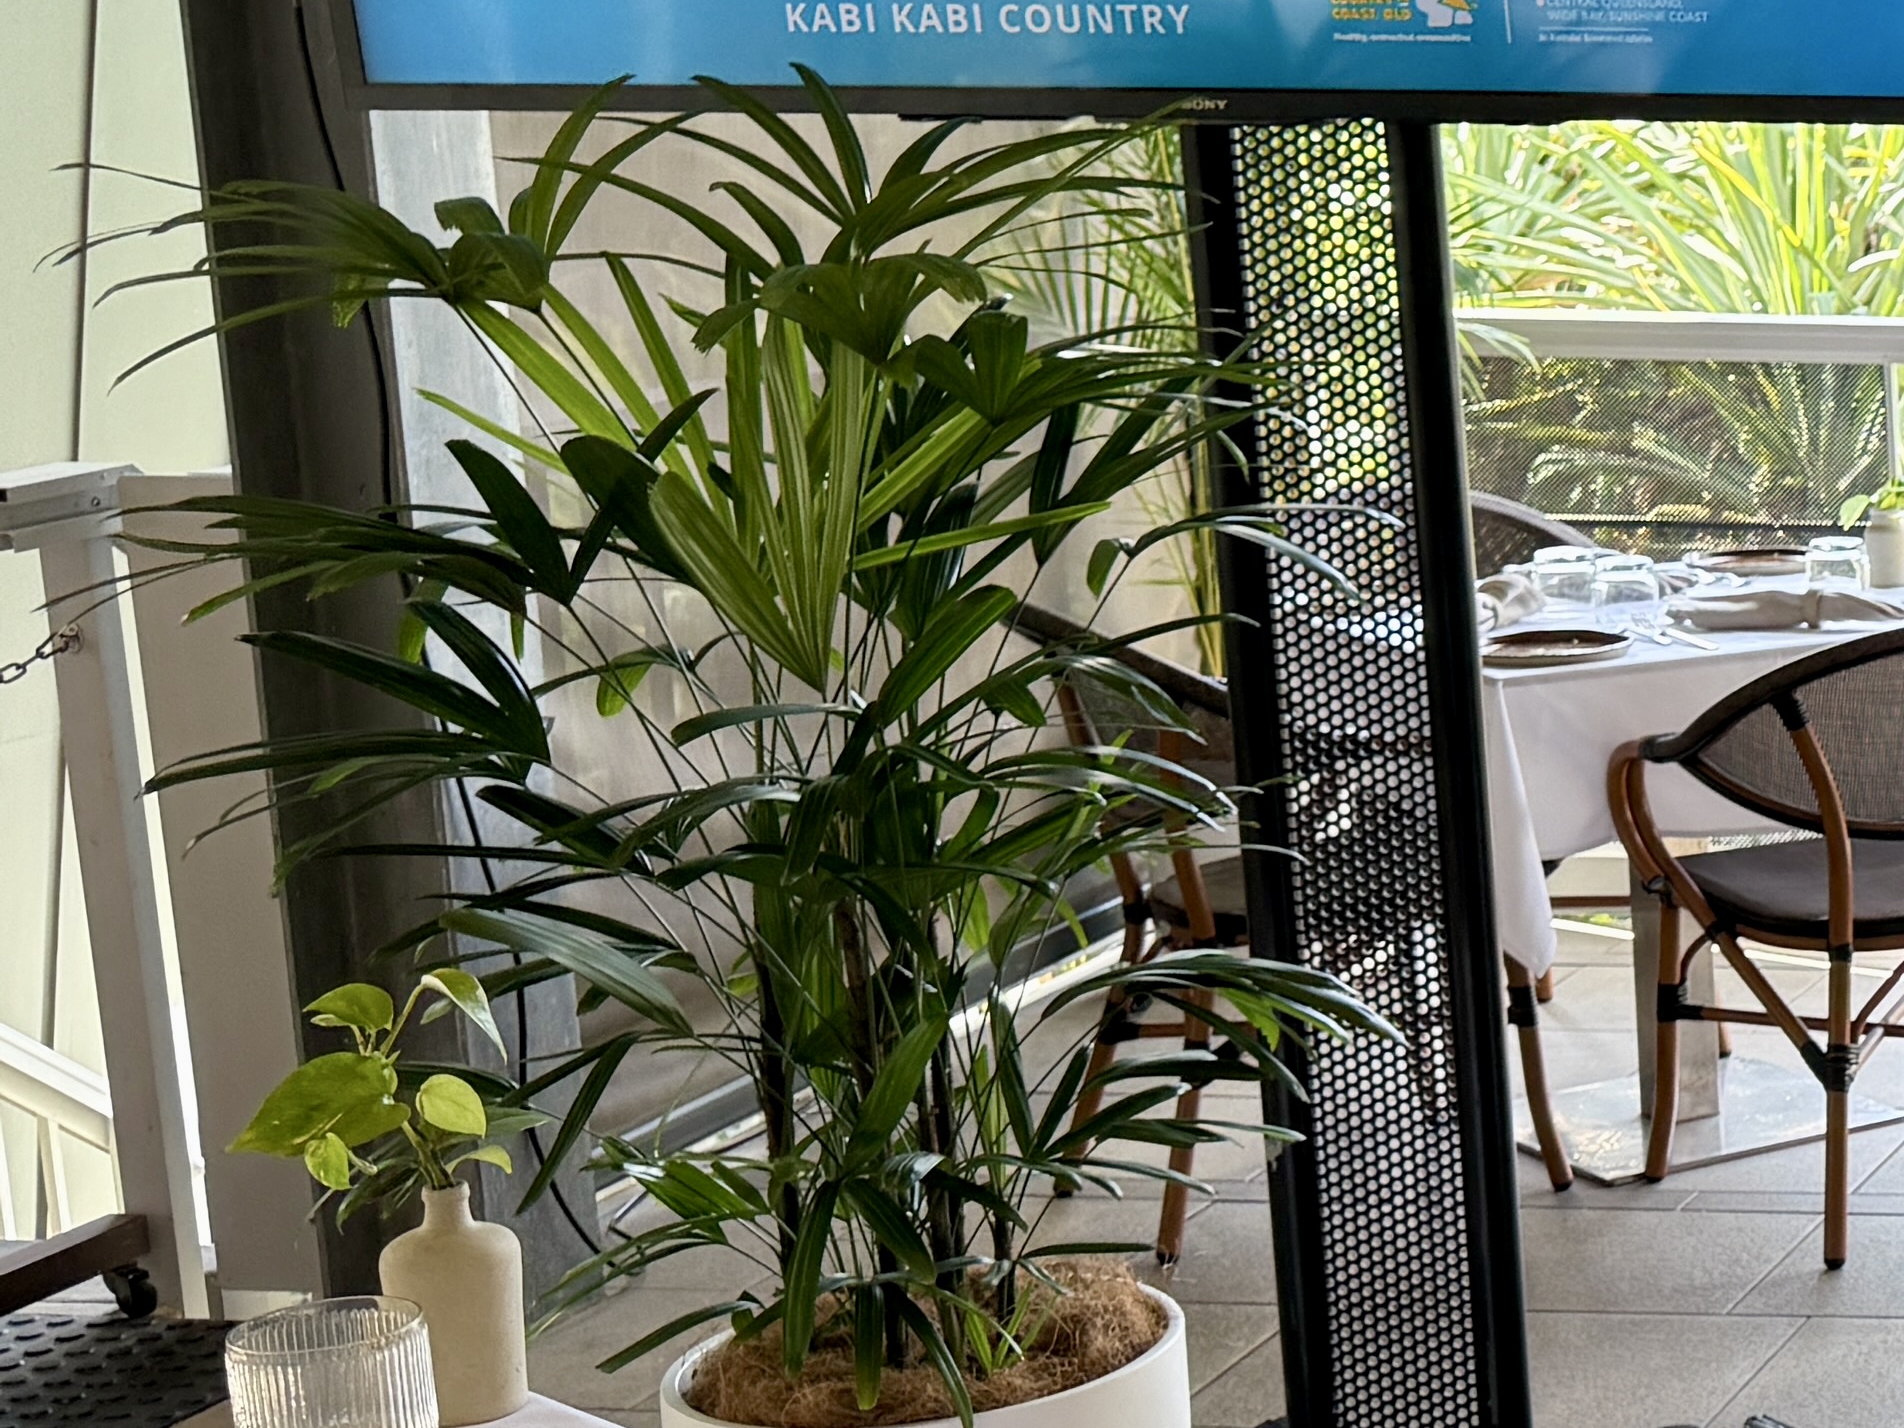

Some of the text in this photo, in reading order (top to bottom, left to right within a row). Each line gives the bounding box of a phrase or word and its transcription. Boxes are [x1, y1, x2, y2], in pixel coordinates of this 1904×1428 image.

[785, 1, 1191, 36] KABI KABI COUNTRY
